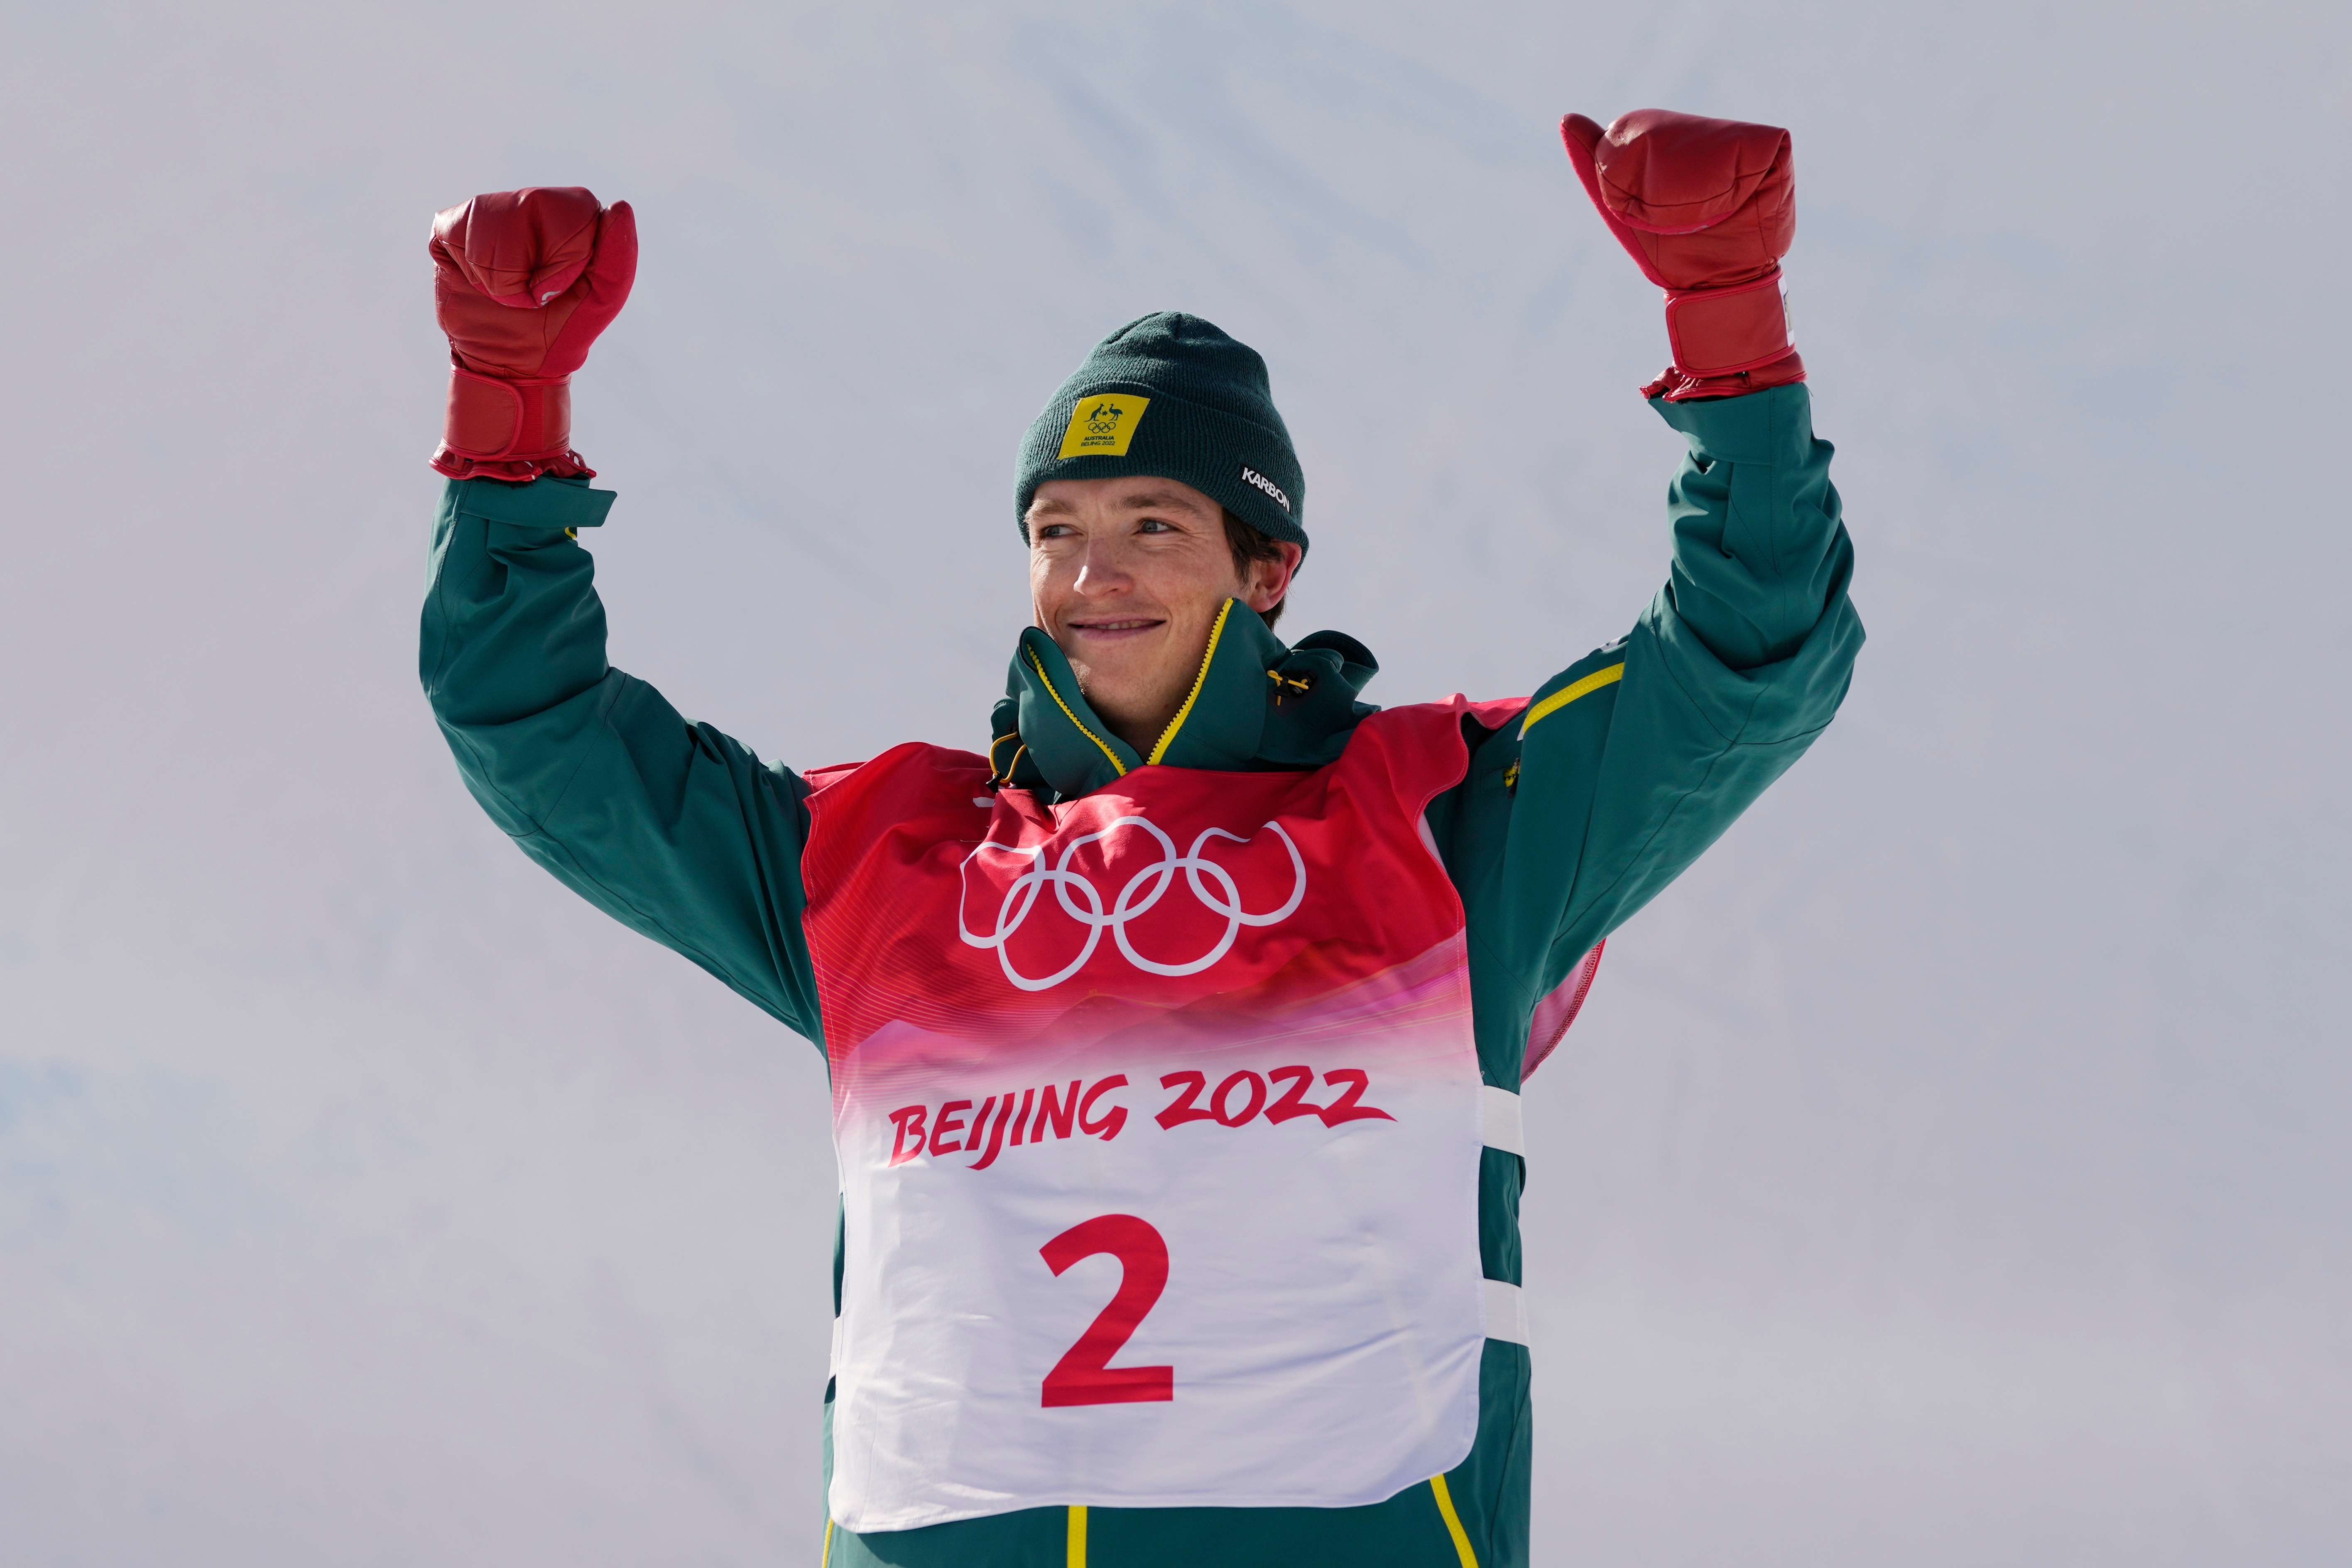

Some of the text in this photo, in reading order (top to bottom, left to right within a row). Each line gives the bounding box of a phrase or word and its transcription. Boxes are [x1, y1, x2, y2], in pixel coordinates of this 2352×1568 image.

[1242, 467, 1290, 512] KARBON
[887, 1065, 1399, 1171] BEIJING 2022
[1039, 1214, 1174, 1408] 2
